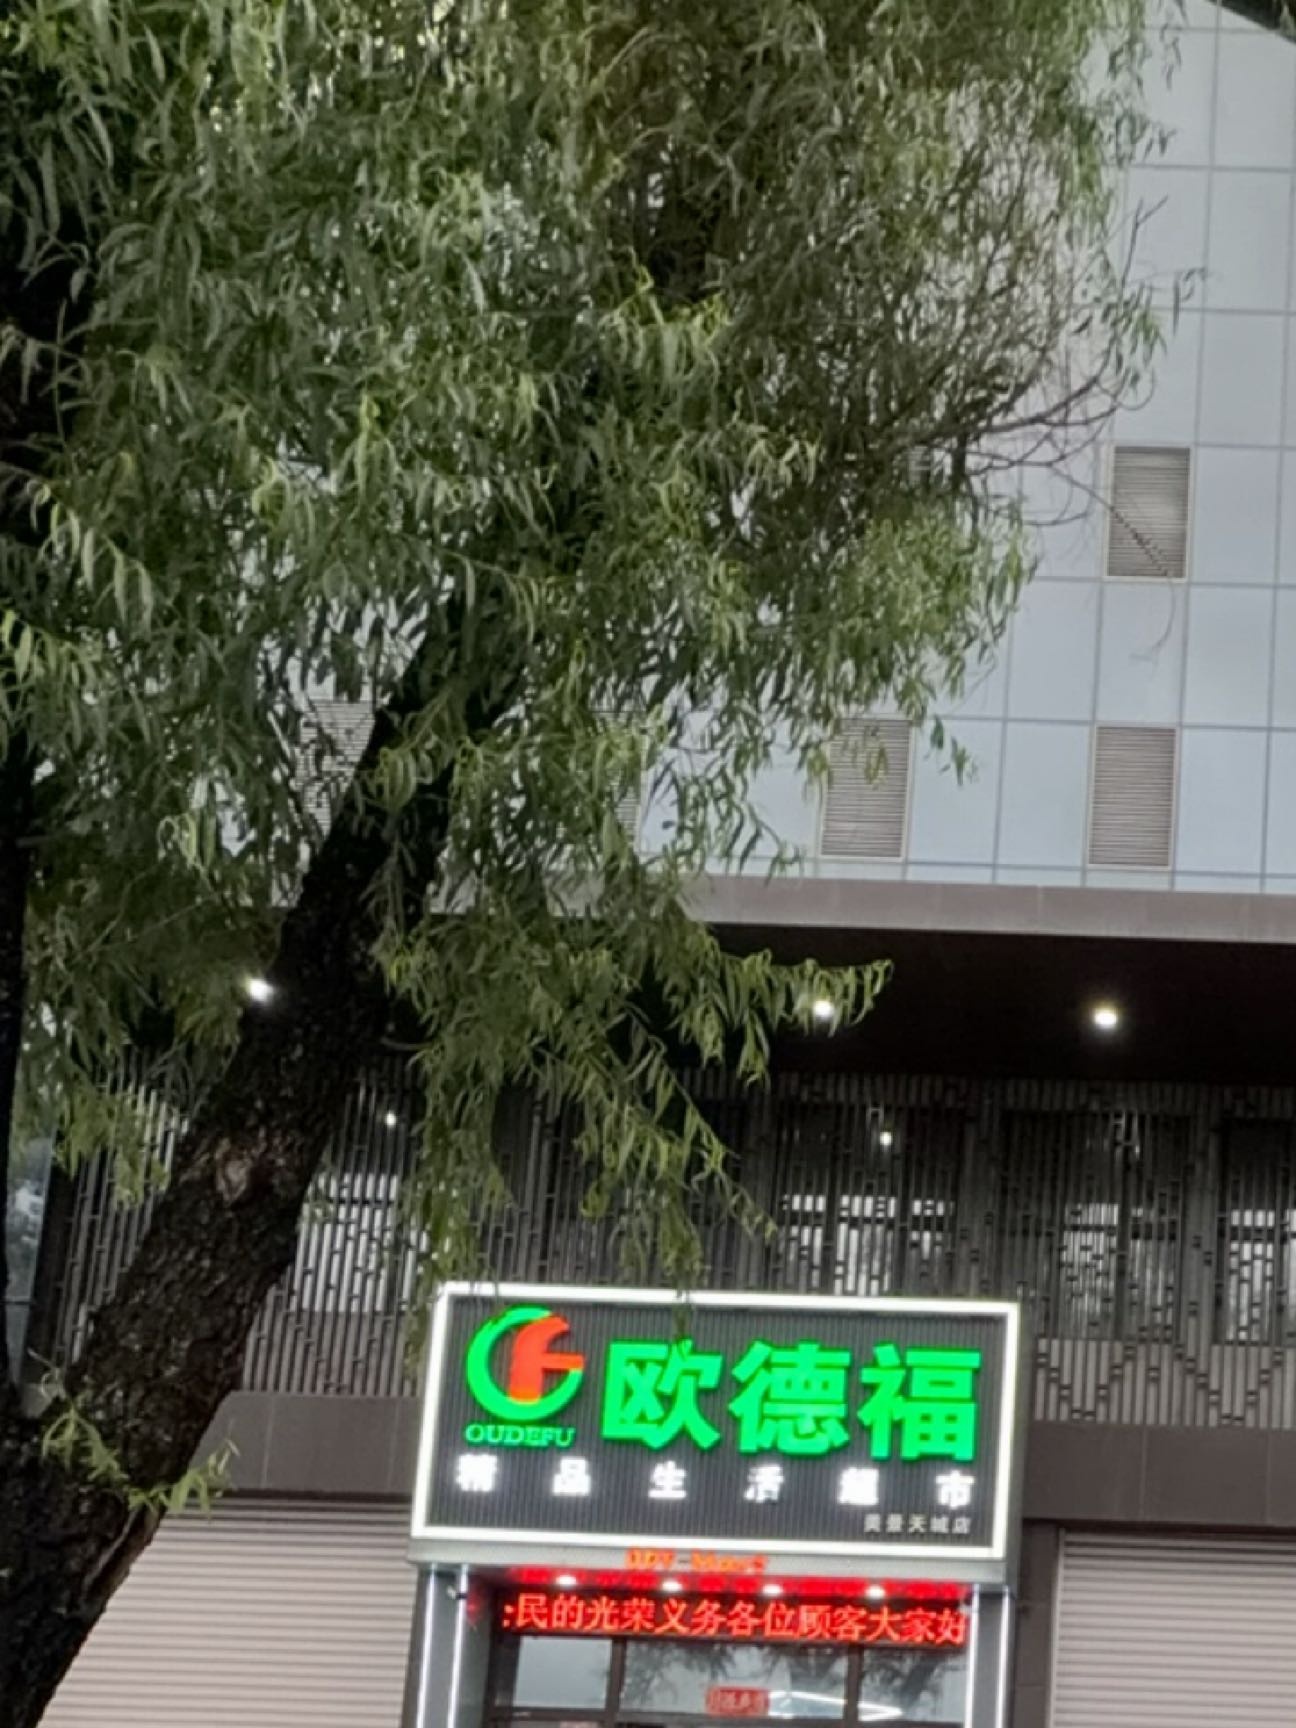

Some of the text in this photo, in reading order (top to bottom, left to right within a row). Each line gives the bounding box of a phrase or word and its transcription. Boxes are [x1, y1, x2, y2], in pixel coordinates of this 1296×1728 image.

[601, 1338, 981, 1461] 欧德福
[465, 1422, 576, 1449] OUDEFU
[503, 1592, 967, 1646] 民的光荣义务各位顾客大家好
